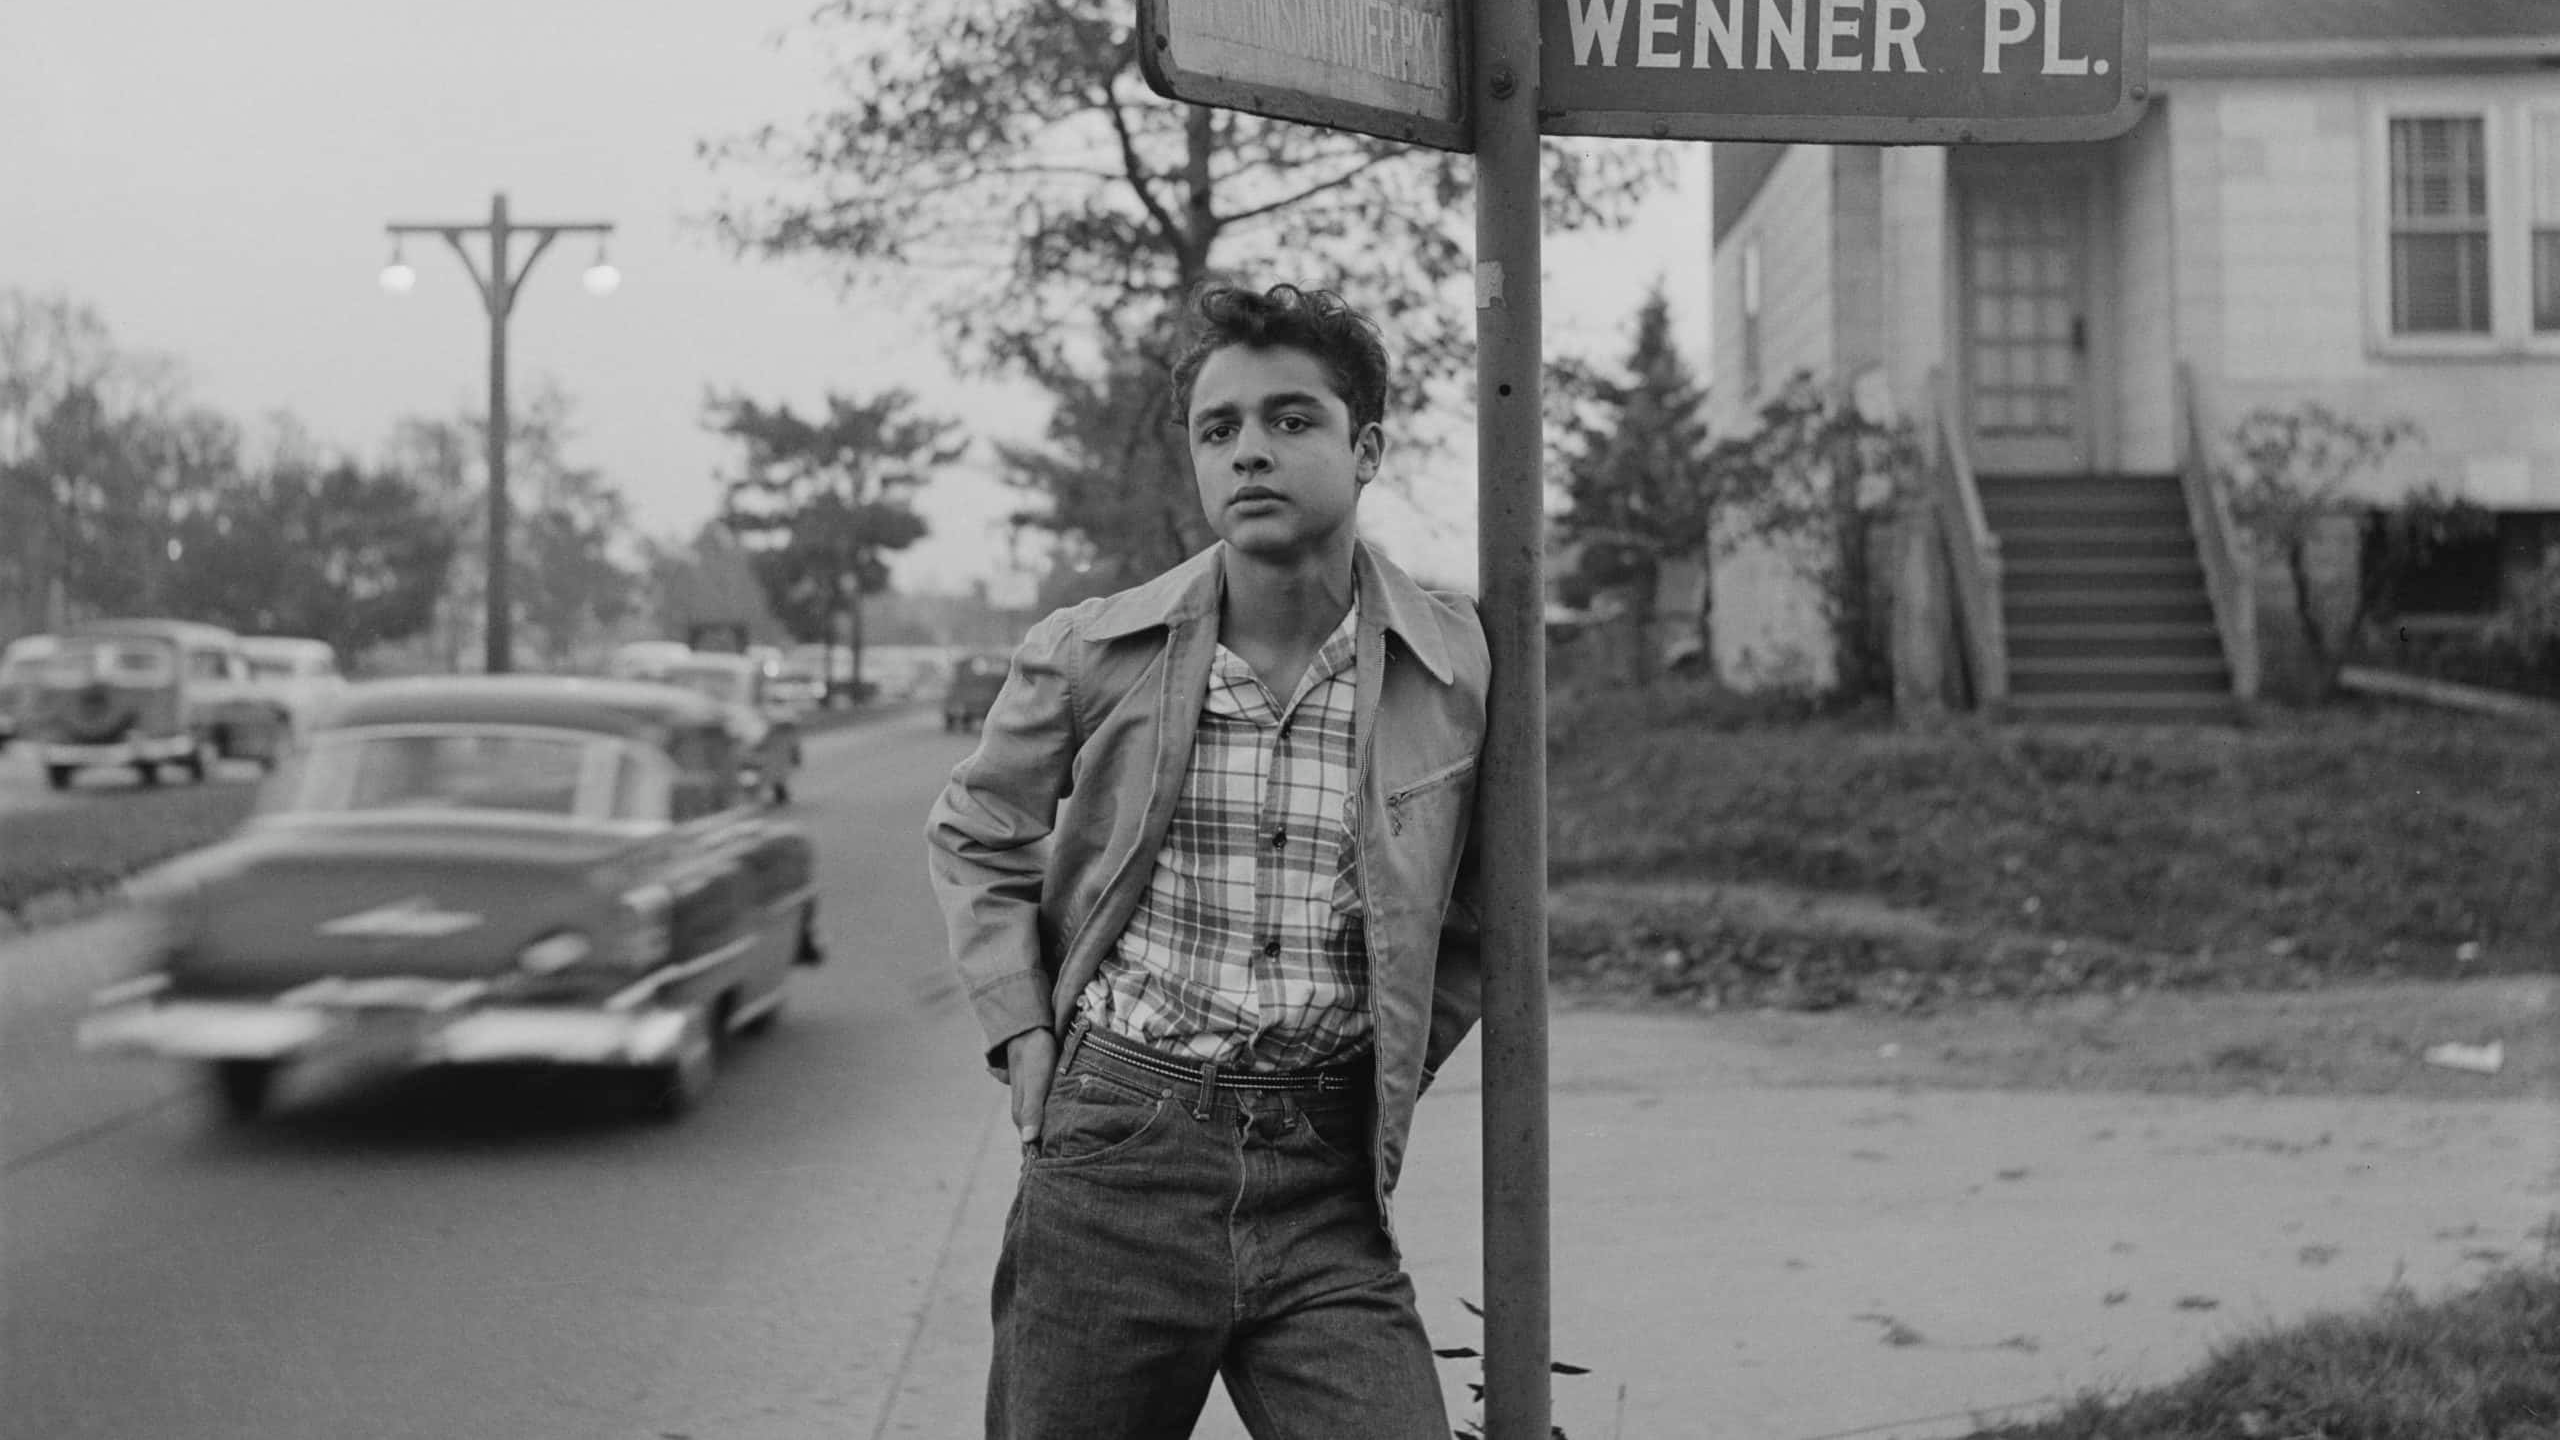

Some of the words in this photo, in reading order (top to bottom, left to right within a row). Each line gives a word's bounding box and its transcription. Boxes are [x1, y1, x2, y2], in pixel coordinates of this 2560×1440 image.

[1331, 0, 1396, 79] RIVER
[1400, 5, 1444, 89] PKY
[1566, 0, 1928, 73] WENNER
[1982, 0, 2110, 76] PL.
